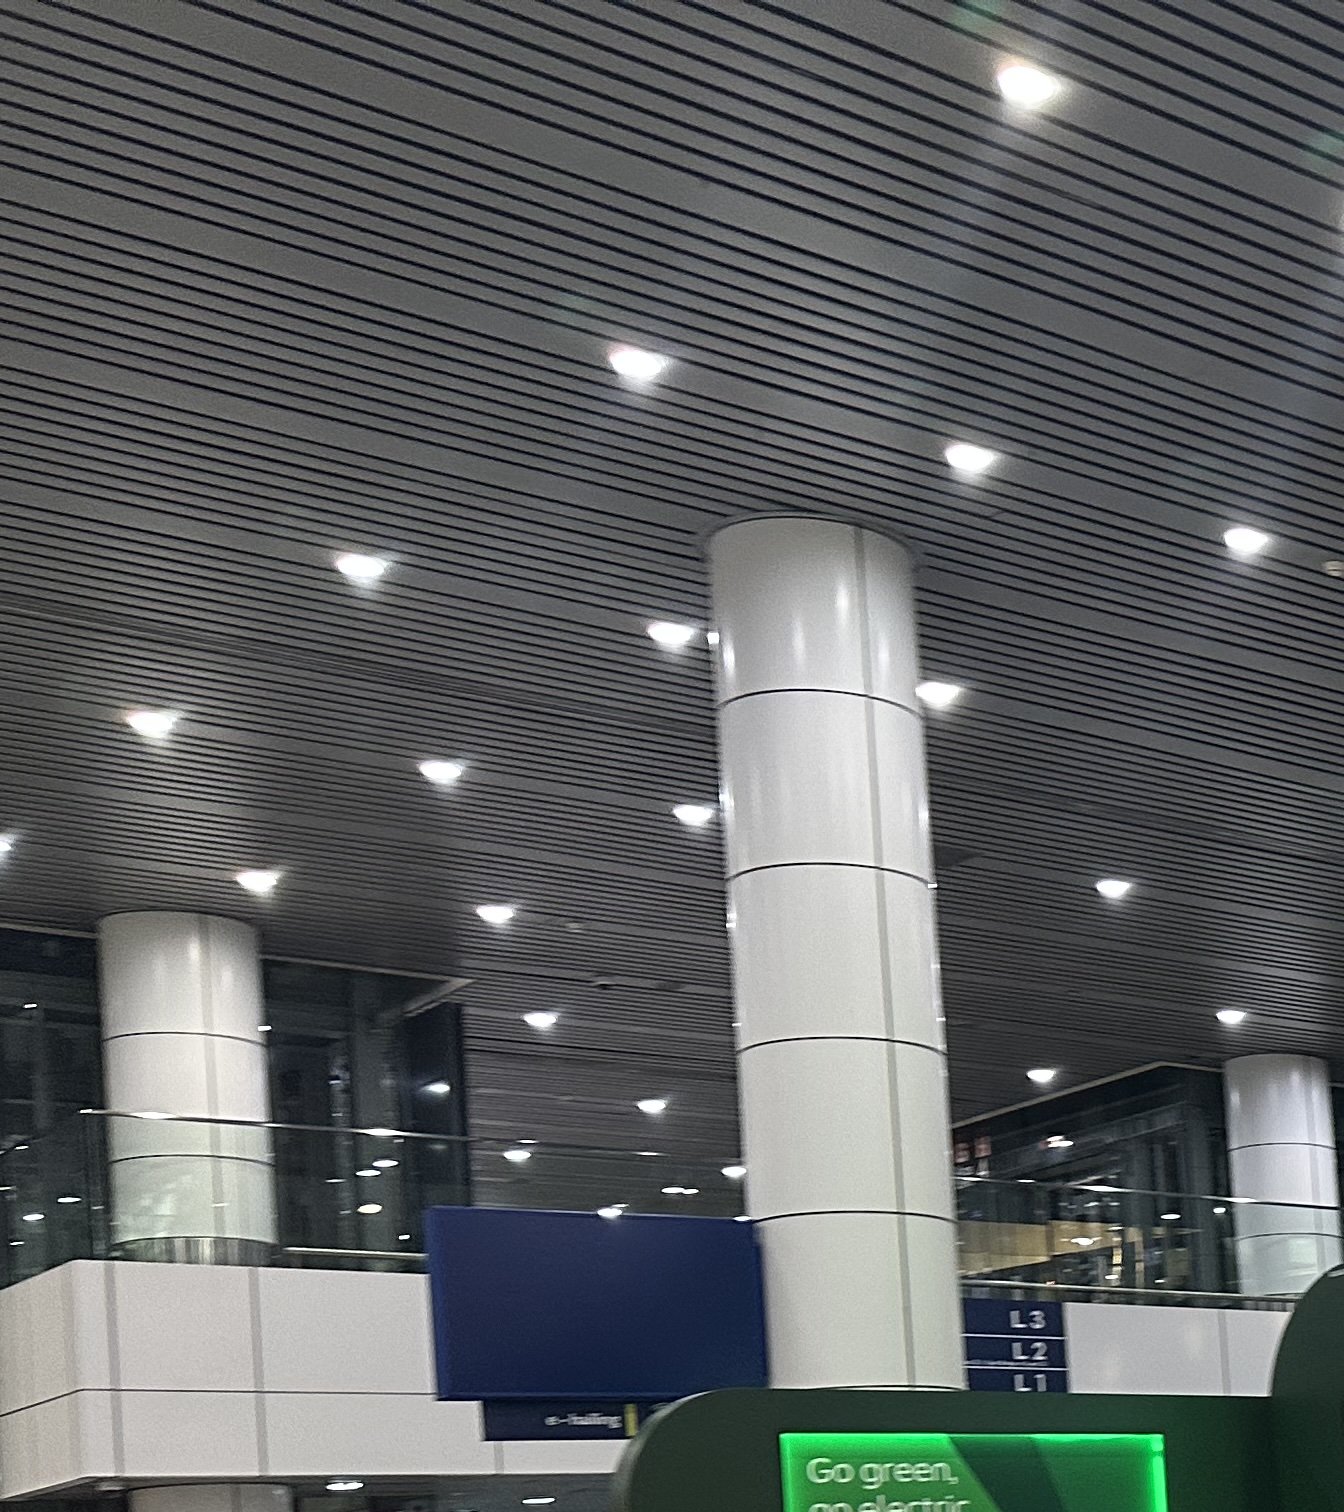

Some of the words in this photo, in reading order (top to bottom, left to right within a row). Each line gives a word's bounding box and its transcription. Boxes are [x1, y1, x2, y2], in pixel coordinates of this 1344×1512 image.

[1009, 1310, 1047, 1329] L3
[1011, 1341, 1049, 1361] L2
[1013, 1373, 1048, 1393] L1
[805, 1457, 856, 1484] Go
[858, 1462, 959, 1489] green,
